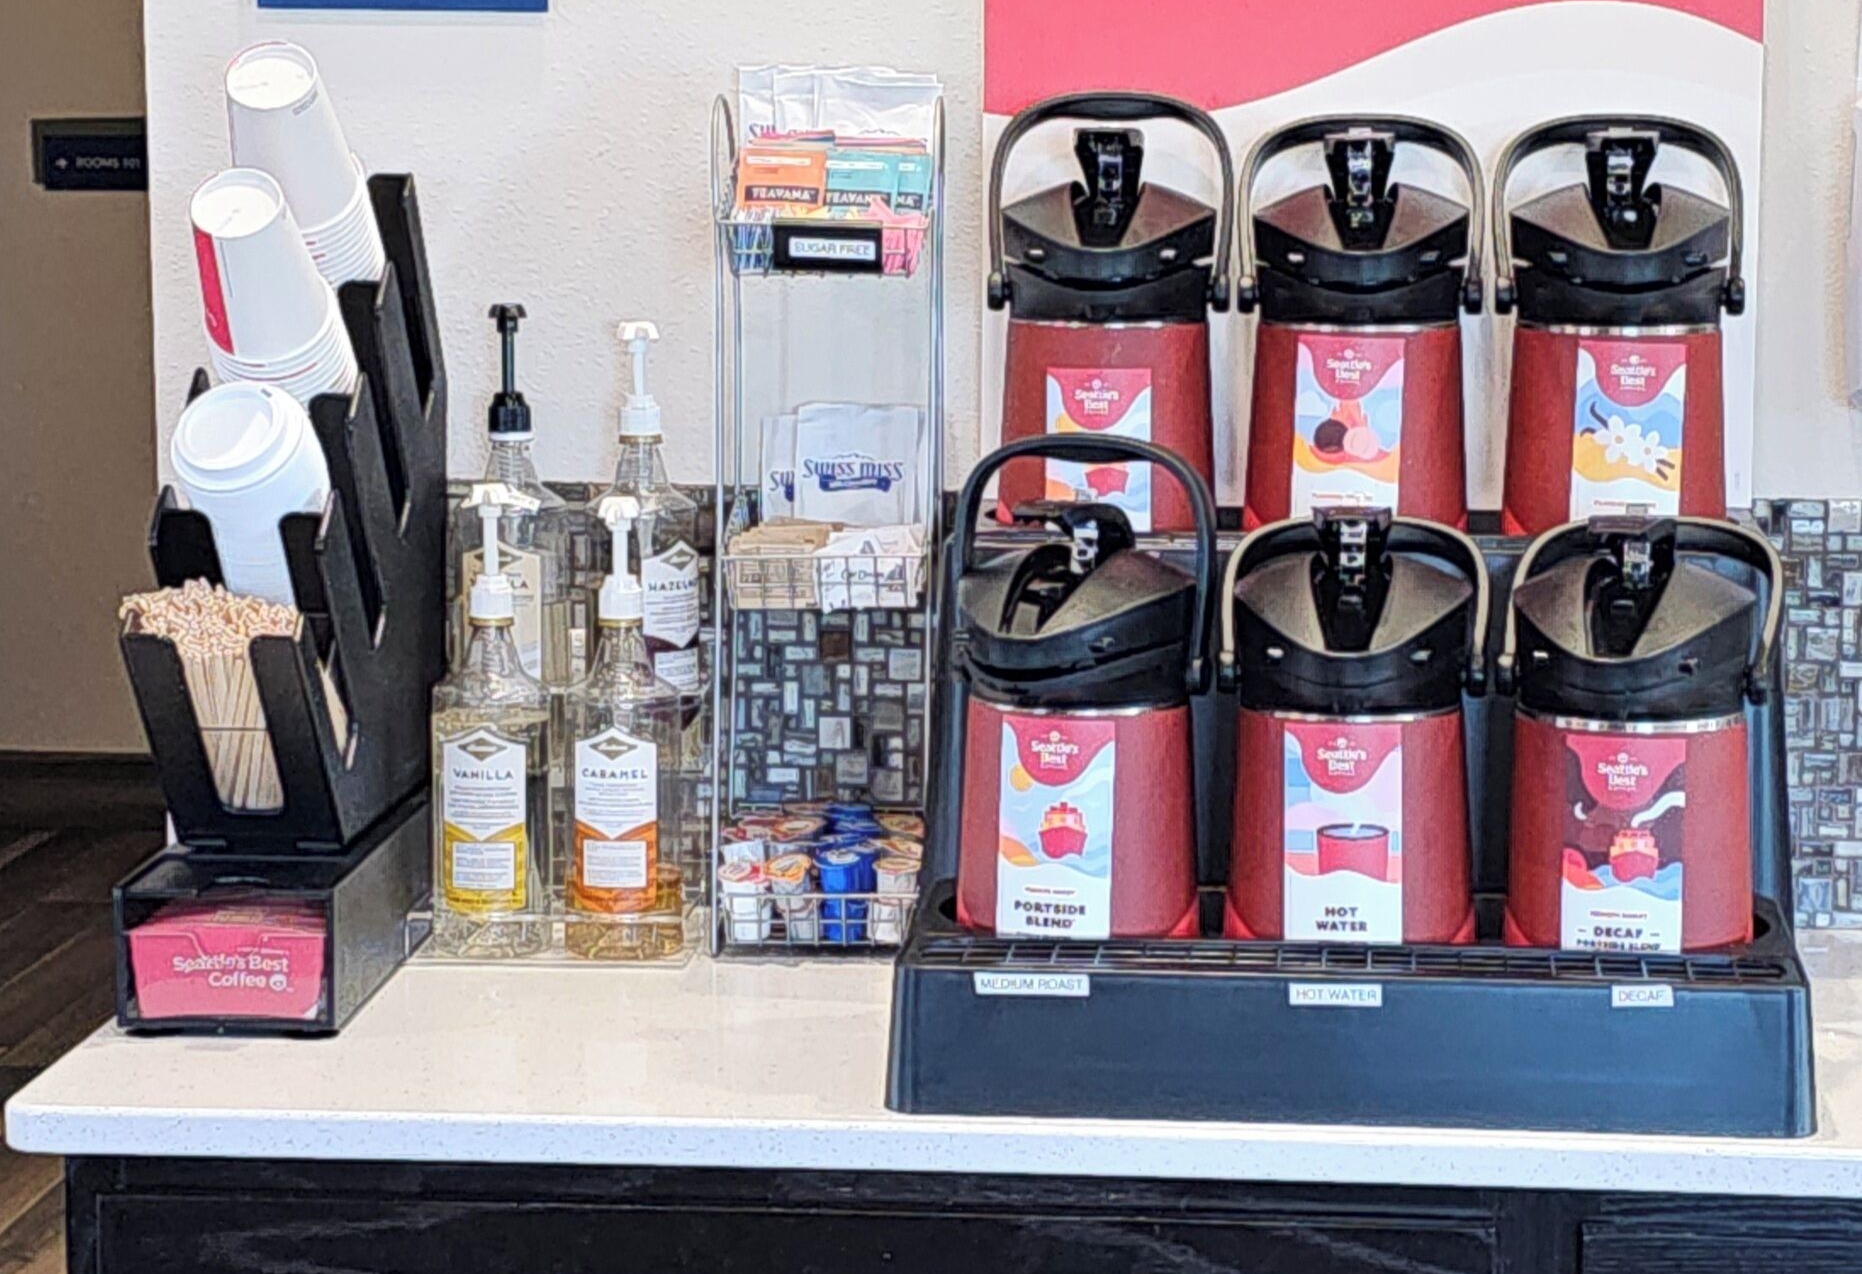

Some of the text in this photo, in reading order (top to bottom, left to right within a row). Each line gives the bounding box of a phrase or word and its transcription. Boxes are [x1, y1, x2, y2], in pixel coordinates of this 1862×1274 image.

[75, 157, 120, 169] ROOMS
[826, 192, 875, 205] TEAVAN
[794, 242, 871, 256] SUGAR FREE
[453, 768, 514, 780] VANILLA
[582, 768, 648, 780] CARAMEL
[1014, 900, 1086, 915] PORTSIDE
[1325, 907, 1358, 918] HOT
[1026, 915, 1072, 928] BLEND
[1315, 920, 1367, 932] WATER
[1593, 926, 1643, 939] DECAF
[173, 955, 288, 973] Seattle's Best
[208, 972, 266, 987] Coffee
[981, 977, 1083, 991] MEDIUM ROAST
[1296, 988, 1377, 1001] HOT WATER
[1618, 990, 1666, 1002] DECAF
